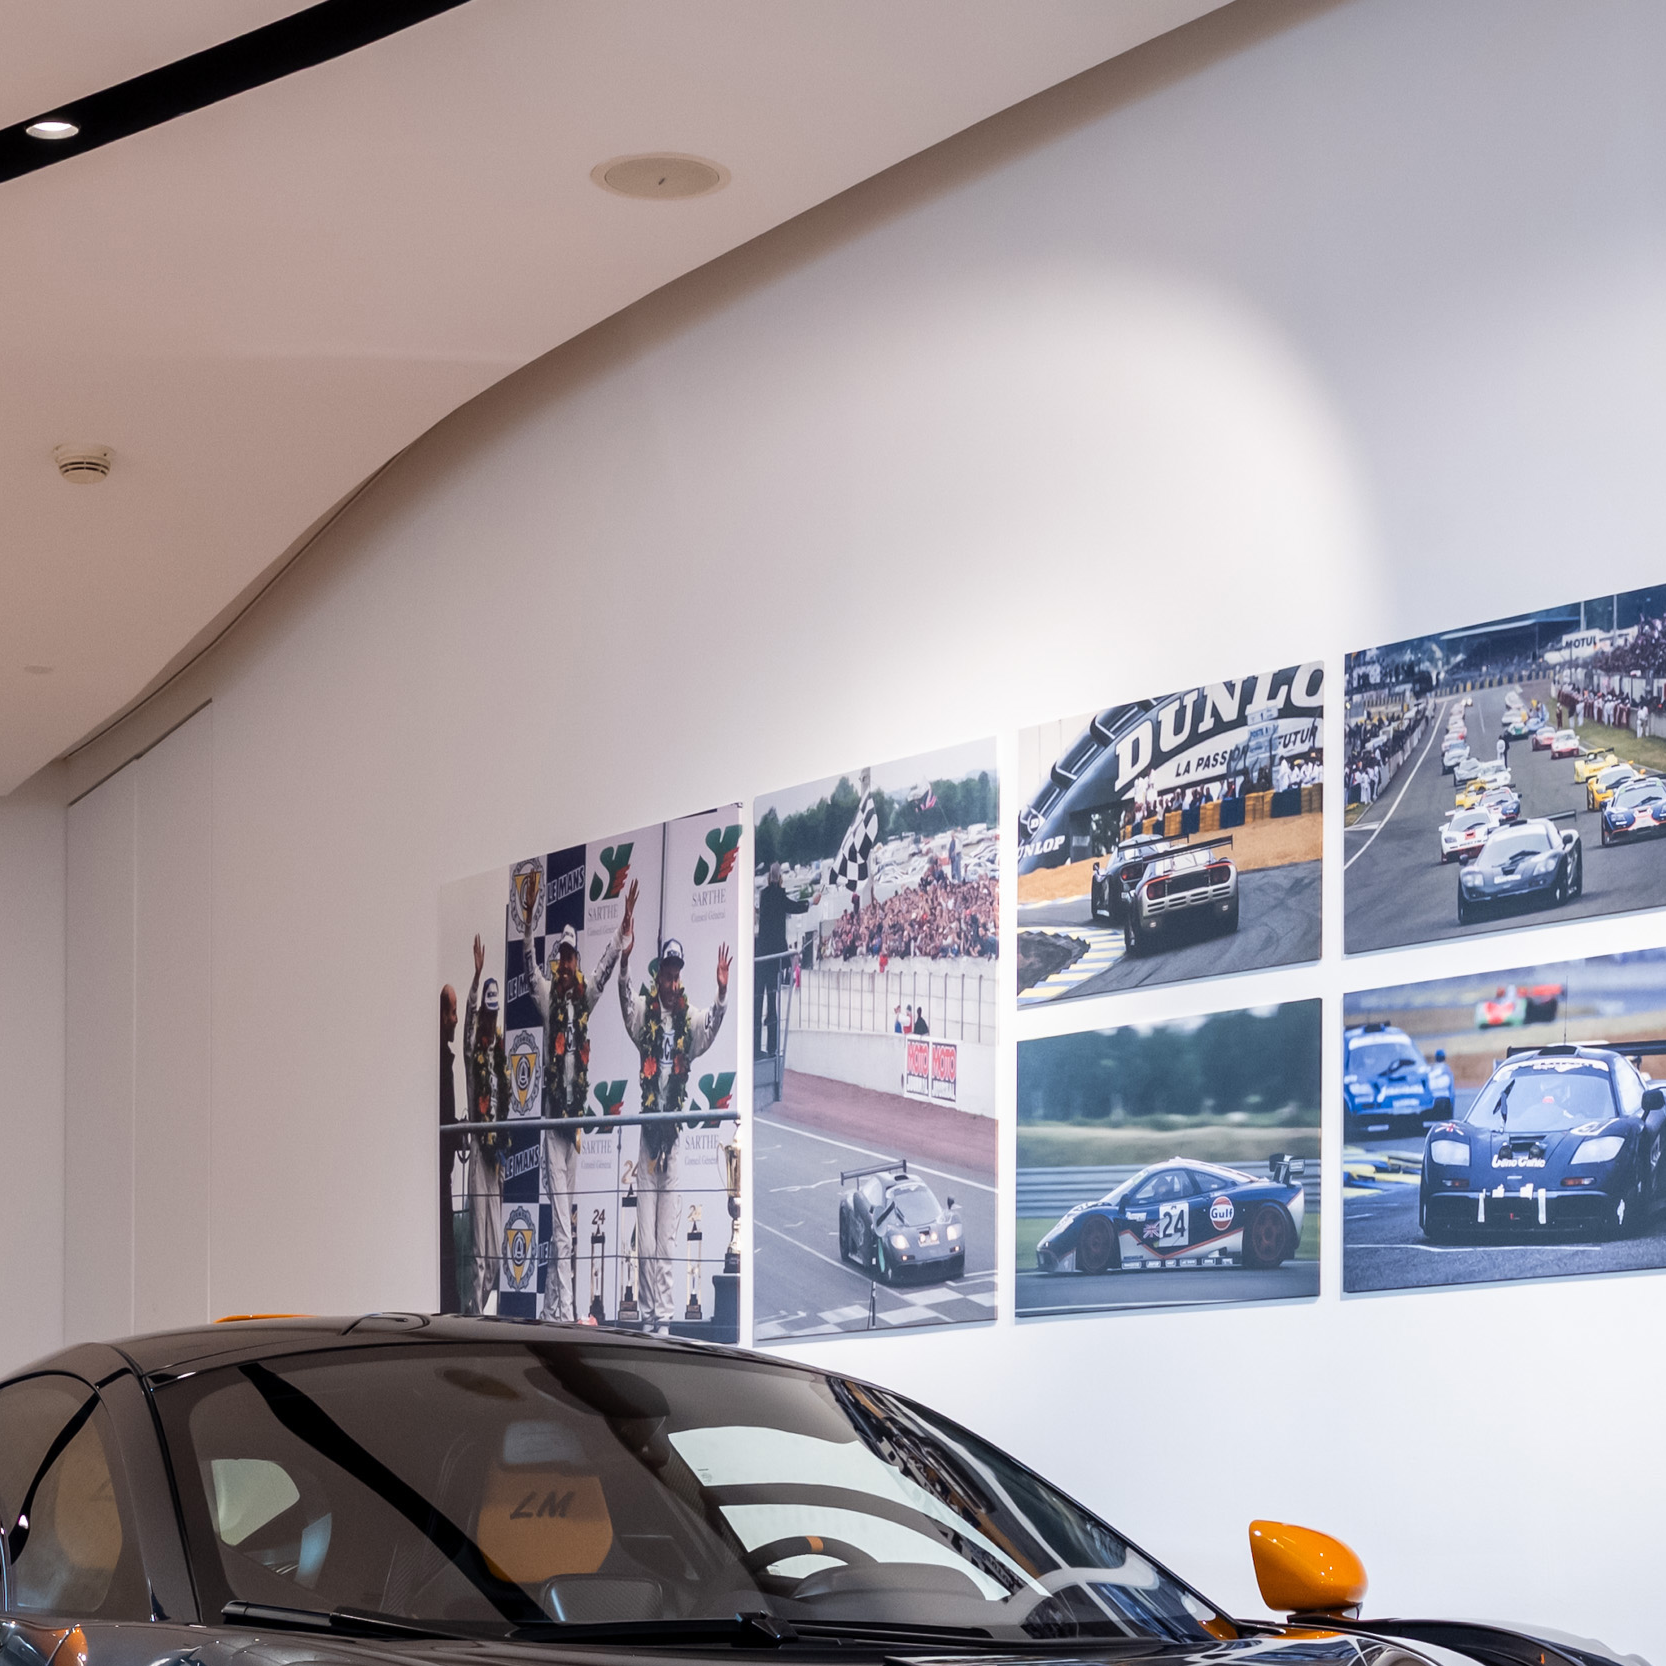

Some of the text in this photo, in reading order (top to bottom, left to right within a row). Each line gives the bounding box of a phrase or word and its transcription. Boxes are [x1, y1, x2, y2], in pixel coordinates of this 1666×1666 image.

[1175, 761, 1191, 777] LA
[558, 865, 584, 899] MANS
[692, 888, 726, 908] SARTHE
[588, 903, 618, 922] SARTHE
[582, 1139, 612, 1155] SARTHE
[685, 1134, 719, 1150] SARTHE
[592, 1208, 605, 1225] 24
[1211, 1207, 1234, 1220] Gulf
[1162, 1210, 1185, 1238] 24
[510, 1491, 575, 1520] LM
